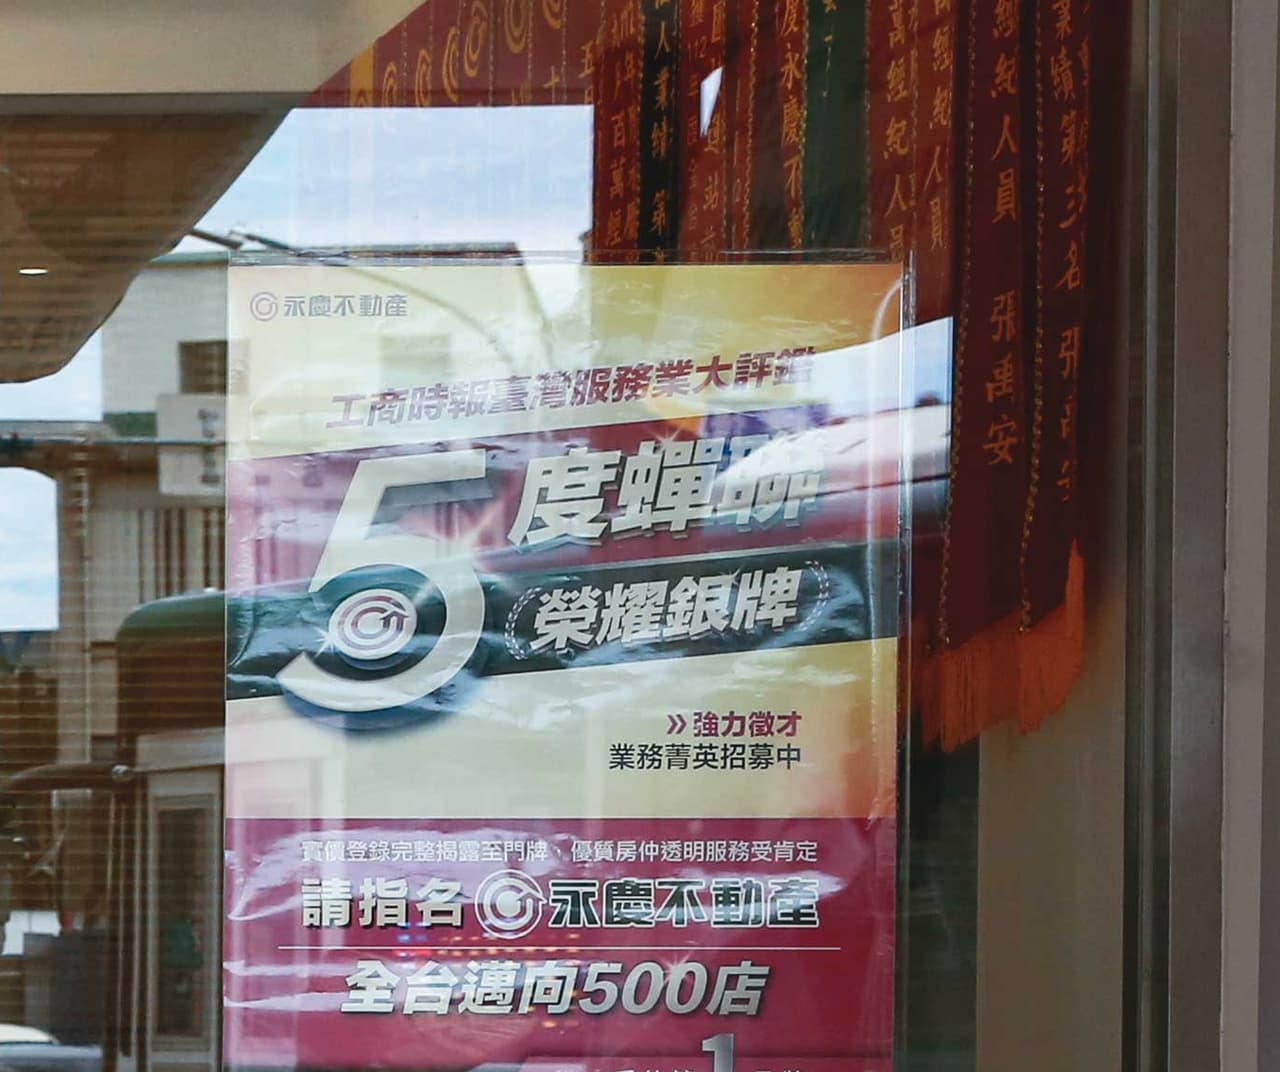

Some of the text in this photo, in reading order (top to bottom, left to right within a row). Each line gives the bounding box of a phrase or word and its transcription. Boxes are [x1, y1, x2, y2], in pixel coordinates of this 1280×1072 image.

[283, 295, 408, 318] 永慶不動產
[530, 566, 803, 655] 榮耀銀牌
[693, 711, 802, 738] 強力徵才
[609, 743, 802, 771] 業務菁英招募中
[571, 840, 818, 863] 優質房仲透明服務受肯定
[301, 877, 820, 929] 請指名 永慶不動產
[339, 961, 770, 1017] 全台邁向500店
